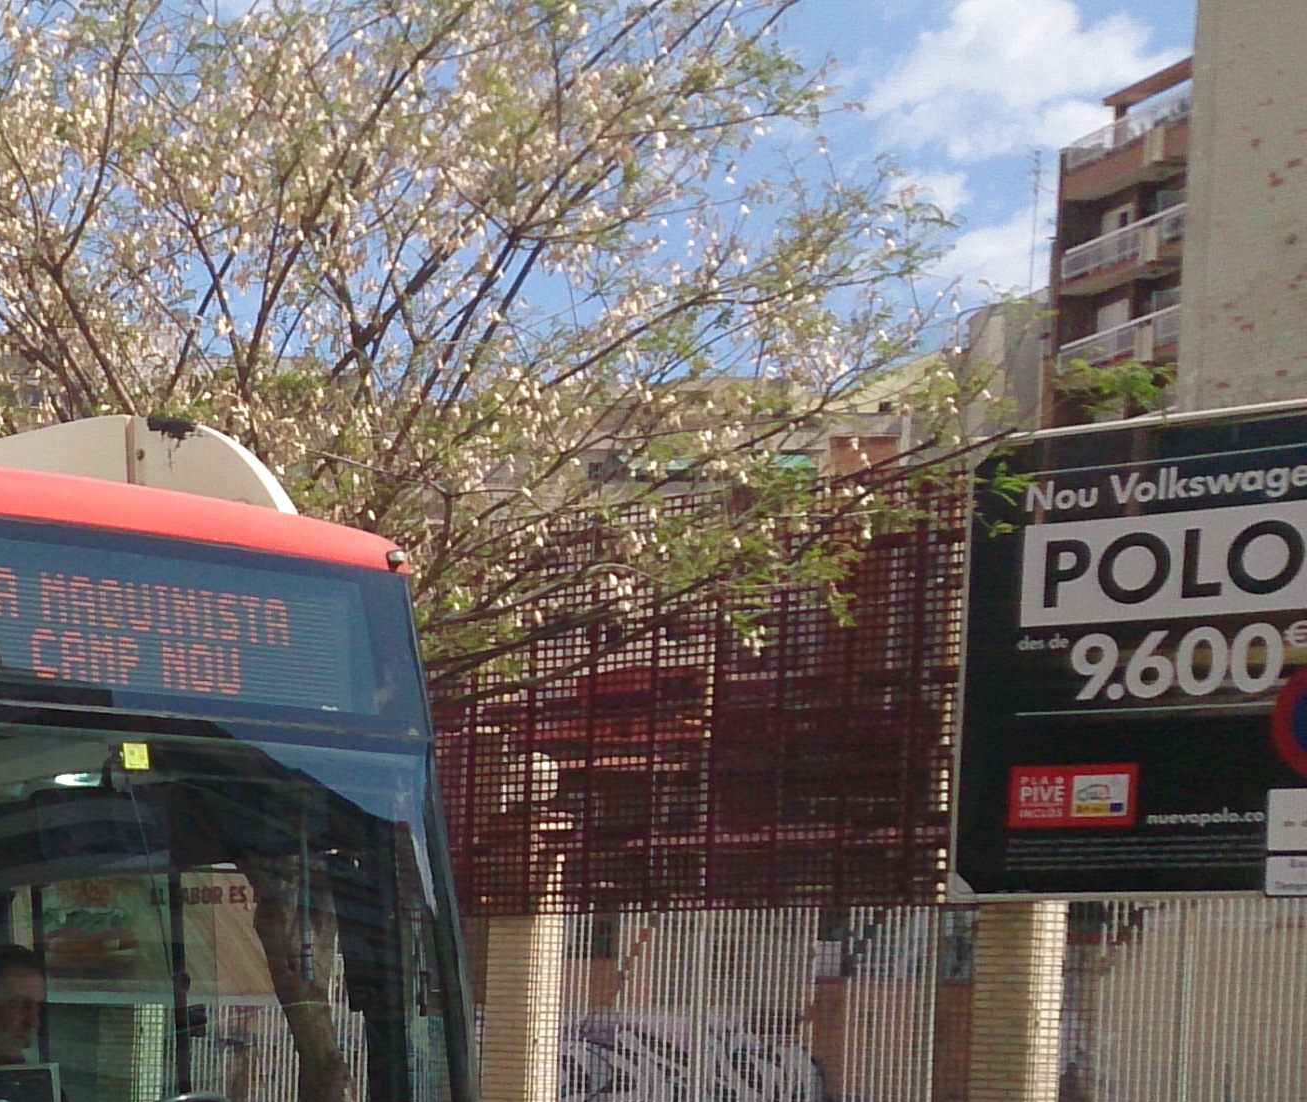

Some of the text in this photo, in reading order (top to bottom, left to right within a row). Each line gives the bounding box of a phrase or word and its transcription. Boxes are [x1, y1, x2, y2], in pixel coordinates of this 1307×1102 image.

[1025, 480, 1098, 512] Nou
[1043, 519, 1305, 609] POLO
[40, 570, 291, 646] MAQUINISTA
[30, 627, 241, 695] CAMP NOU
[1048, 633, 1069, 648] de
[1020, 785, 1065, 802] PIVE
